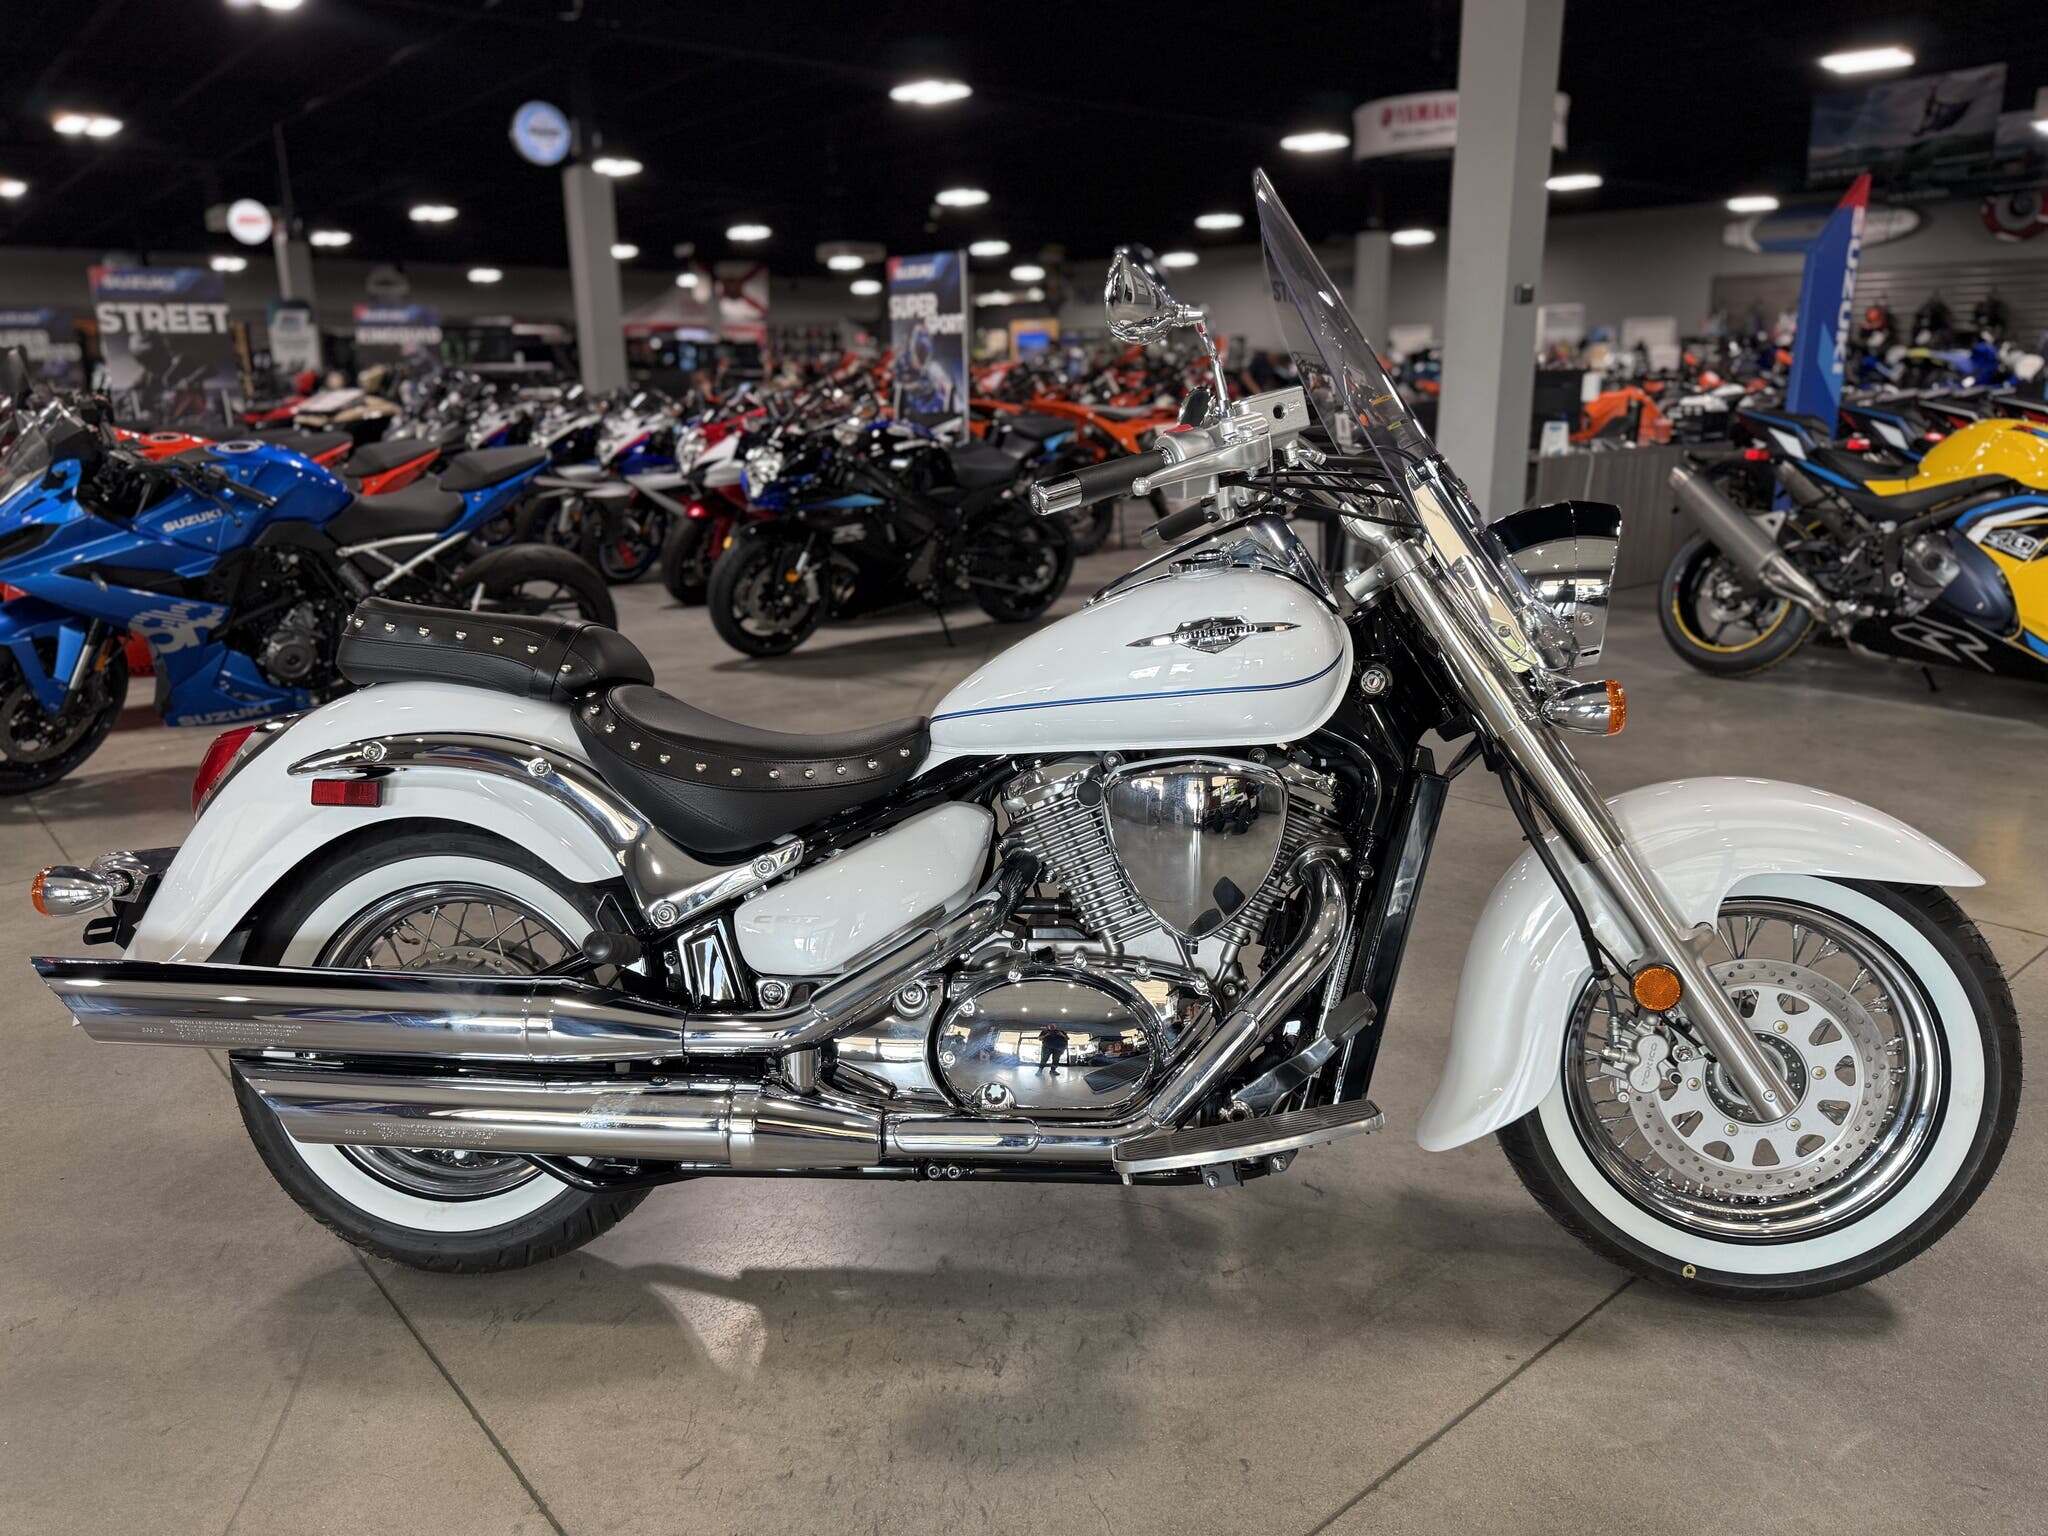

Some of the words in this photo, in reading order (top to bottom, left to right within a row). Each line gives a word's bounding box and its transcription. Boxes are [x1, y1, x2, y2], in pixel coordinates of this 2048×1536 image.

[97, 302, 229, 334] STREET
[163, 508, 223, 533] SUZUKI
[176, 703, 272, 728] SUZUKI
